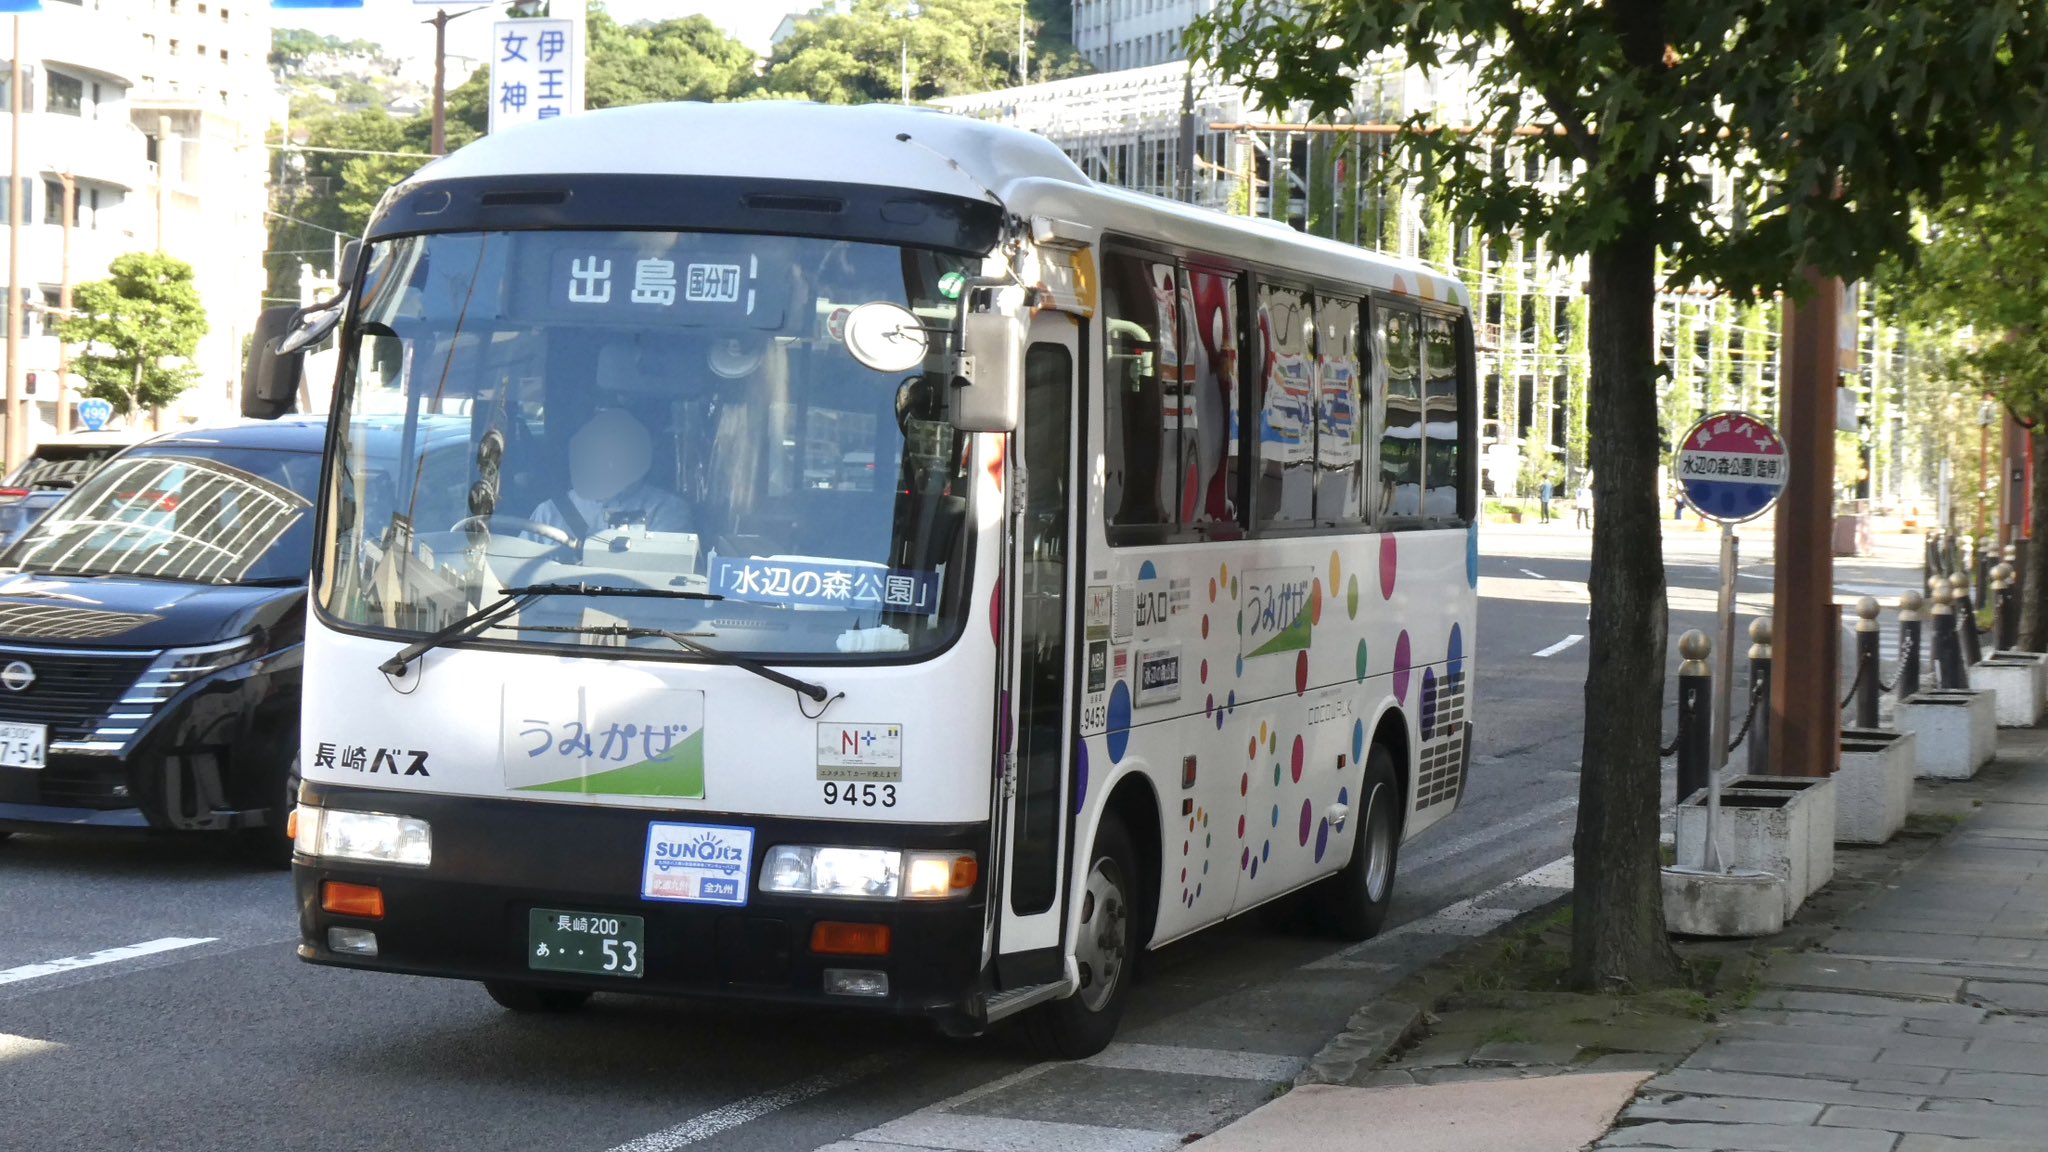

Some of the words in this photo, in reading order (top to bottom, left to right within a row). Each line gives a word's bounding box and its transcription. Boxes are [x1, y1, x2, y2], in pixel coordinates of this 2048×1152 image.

[500, 30, 528, 113] 女神
[568, 255, 677, 306] 出島
[688, 265, 740, 300] 国分町
[720, 563, 927, 607] 「水辺の森公園」
[1136, 592, 1167, 626] 出入口
[1248, 579, 1309, 636] うみかぜ
[314, 741, 431, 777] 長崎バス
[519, 719, 688, 763] うみかぜ
[823, 781, 896, 808] 9453
[704, 882, 734, 895] 全九州
